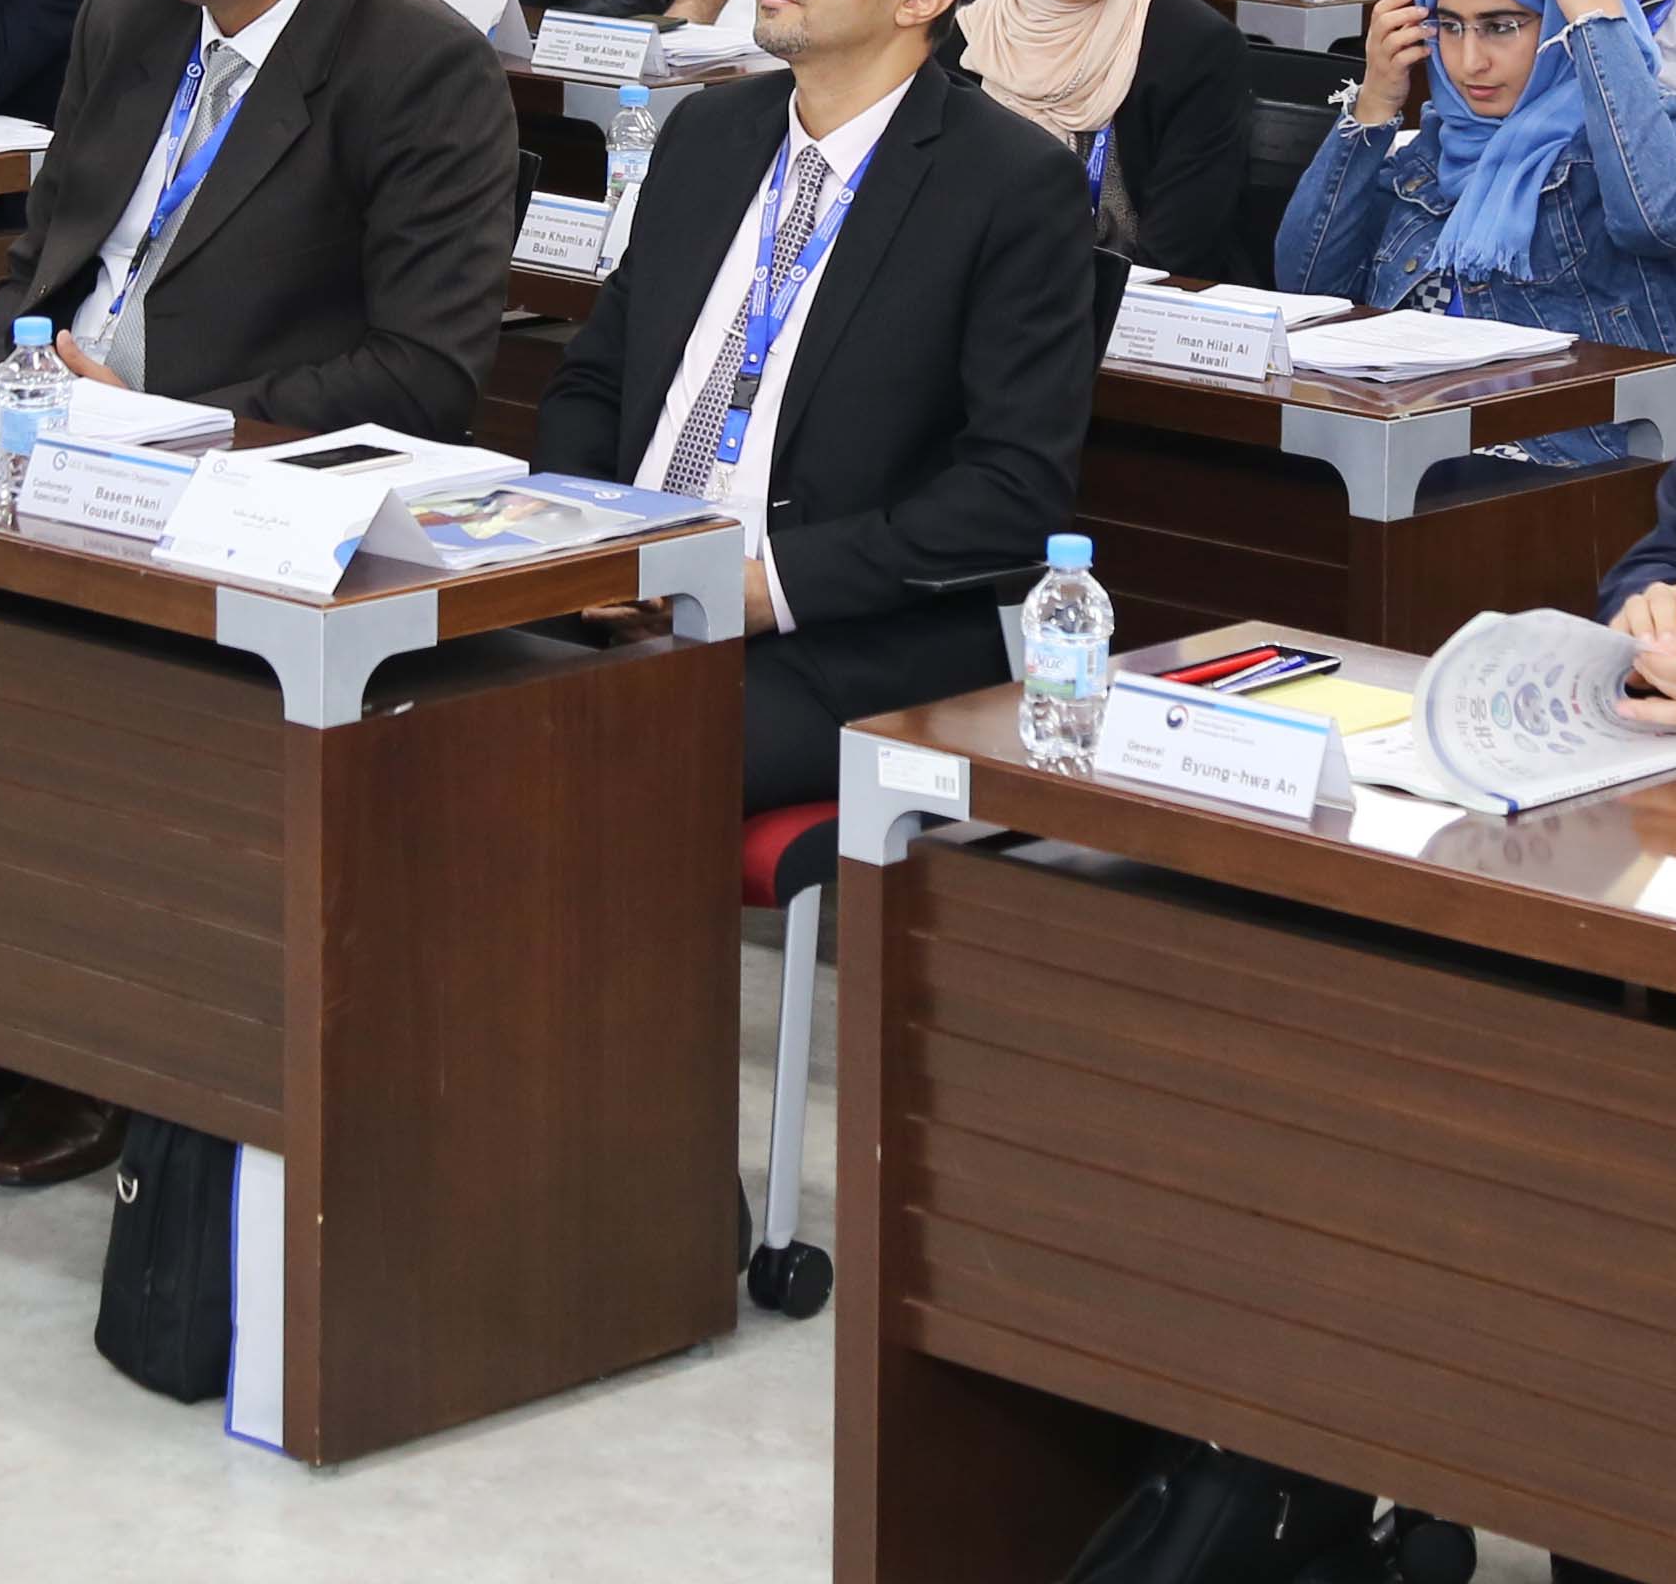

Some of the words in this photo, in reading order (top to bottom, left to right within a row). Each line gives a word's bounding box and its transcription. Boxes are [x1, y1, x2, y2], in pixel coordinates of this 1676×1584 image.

[548, 231, 583, 247] Khamis
[532, 242, 569, 258] Balushi
[1176, 333, 1204, 349] Iman
[1206, 338, 1233, 353] Hilal
[1236, 343, 1250, 355] Al
[1189, 351, 1229, 368] Mawali
[32, 478, 73, 494] Conformity
[95, 485, 133, 506] Basem
[133, 493, 161, 511] Hani
[82, 500, 121, 521] Yousef
[1127, 739, 1166, 757] General
[1122, 752, 1162, 771] Director
[1181, 756, 1271, 791] Byung-hwa
[1274, 776, 1298, 797] An
